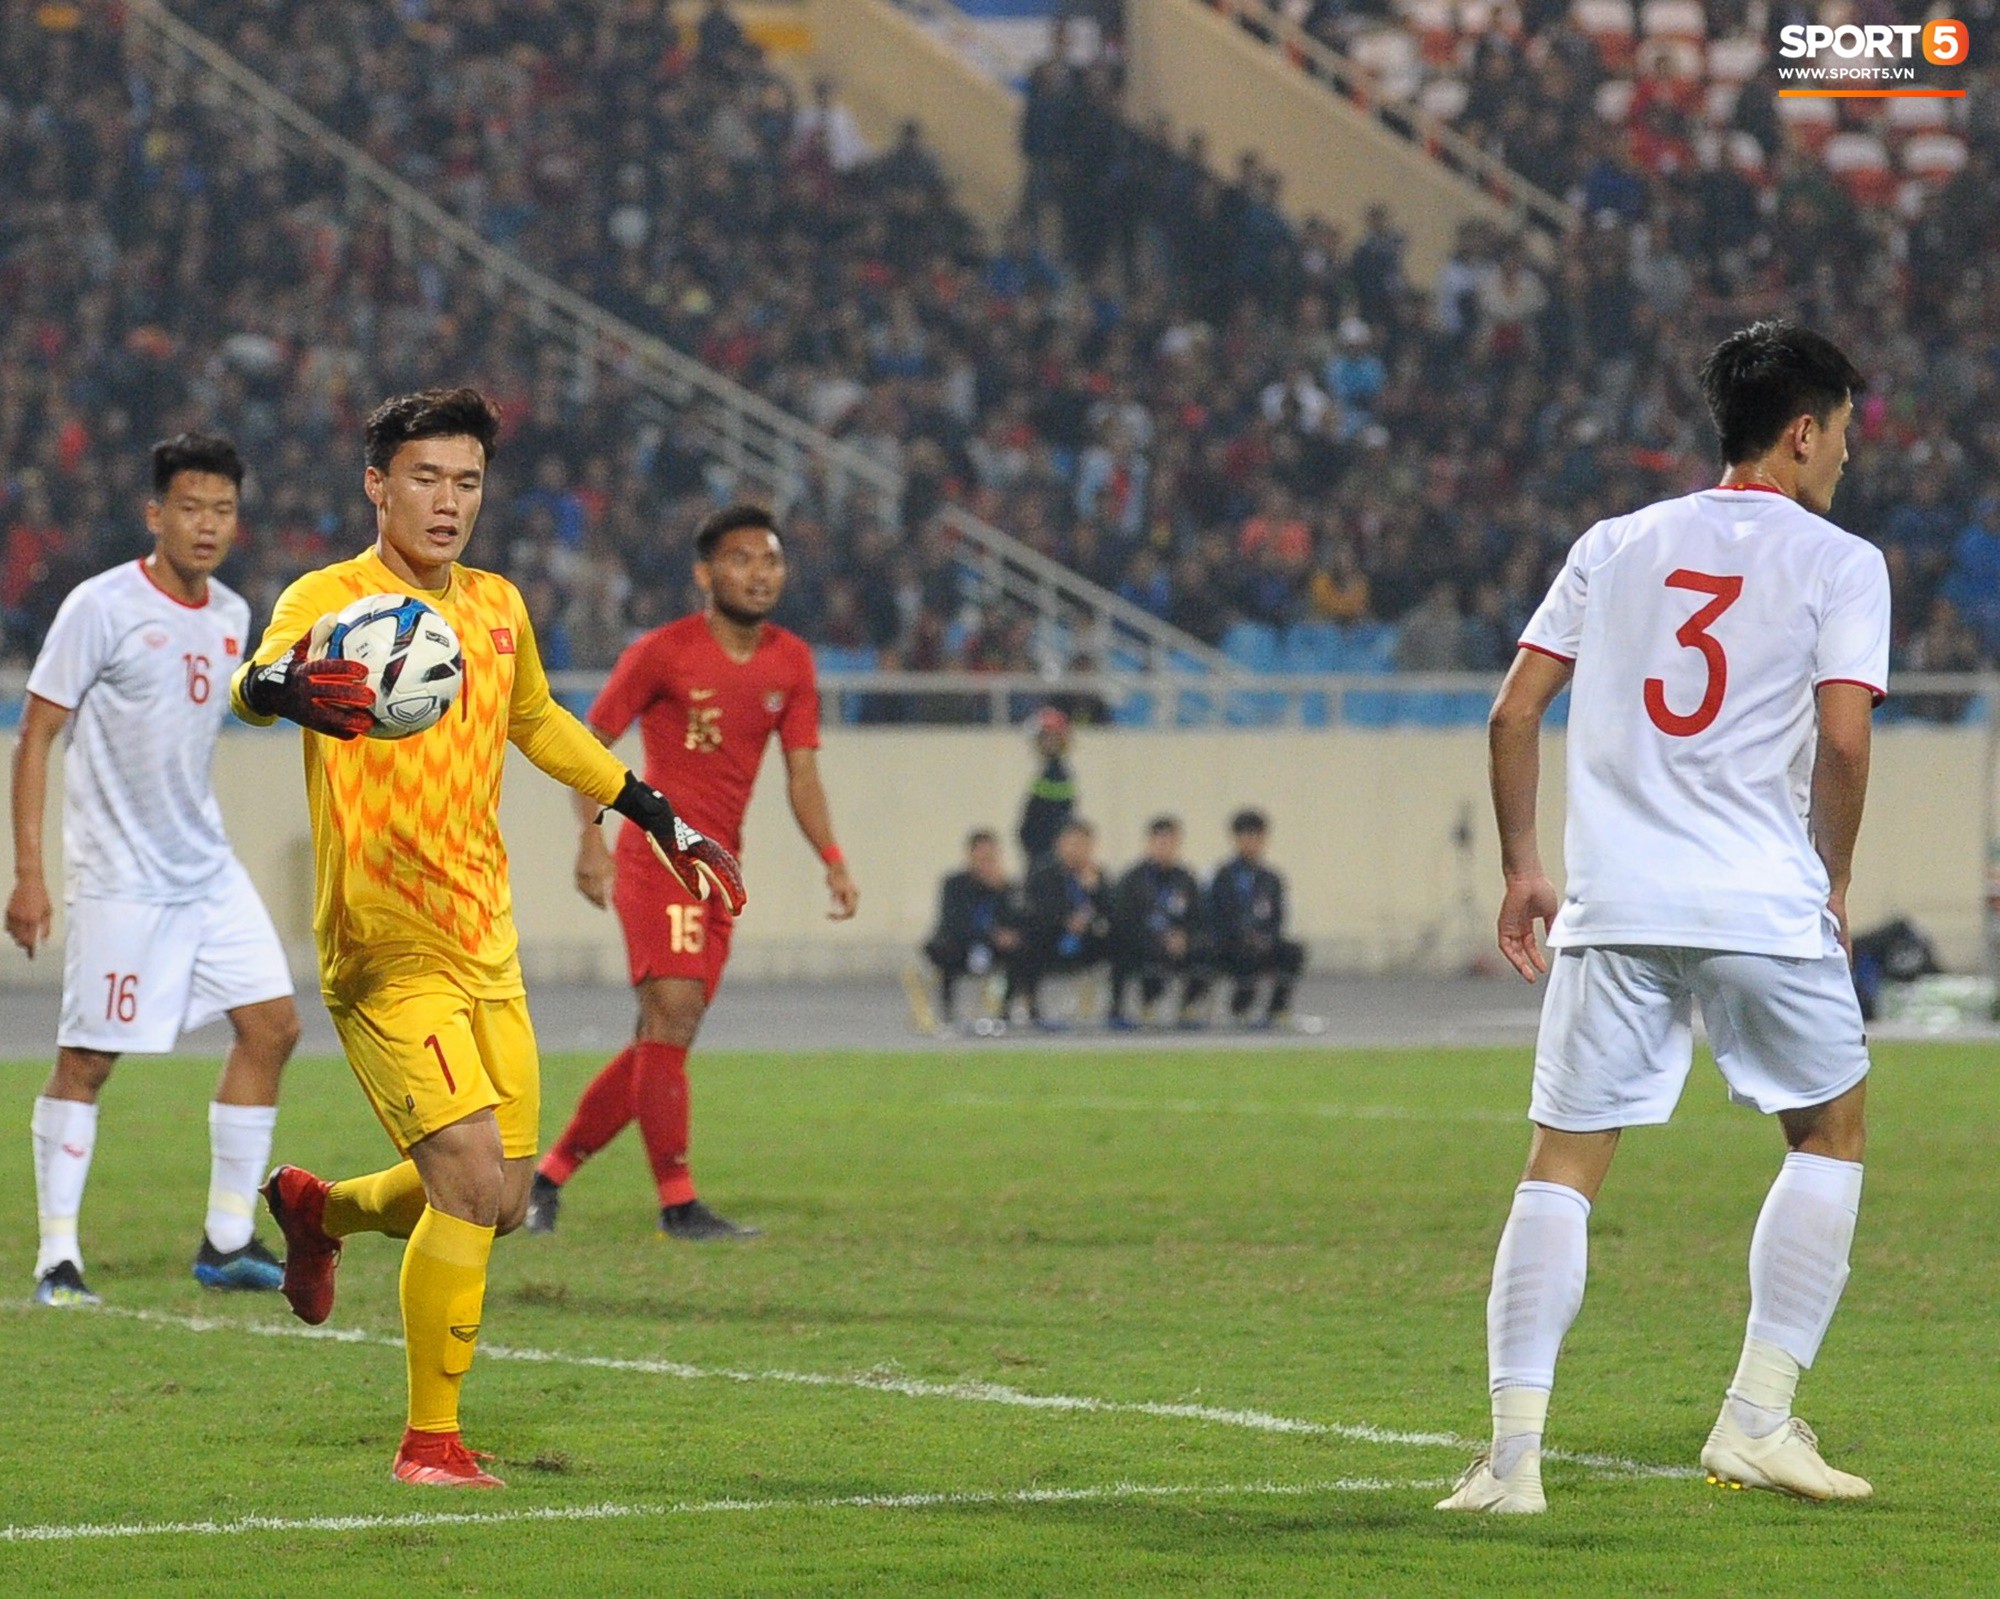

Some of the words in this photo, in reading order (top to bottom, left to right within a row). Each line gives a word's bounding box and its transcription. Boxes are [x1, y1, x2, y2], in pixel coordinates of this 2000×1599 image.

[1643, 568, 1745, 737] 3
[183, 653, 211, 705] 16
[666, 904, 706, 954] 15
[106, 972, 138, 1023] 16
[424, 1034, 456, 1094] 1
